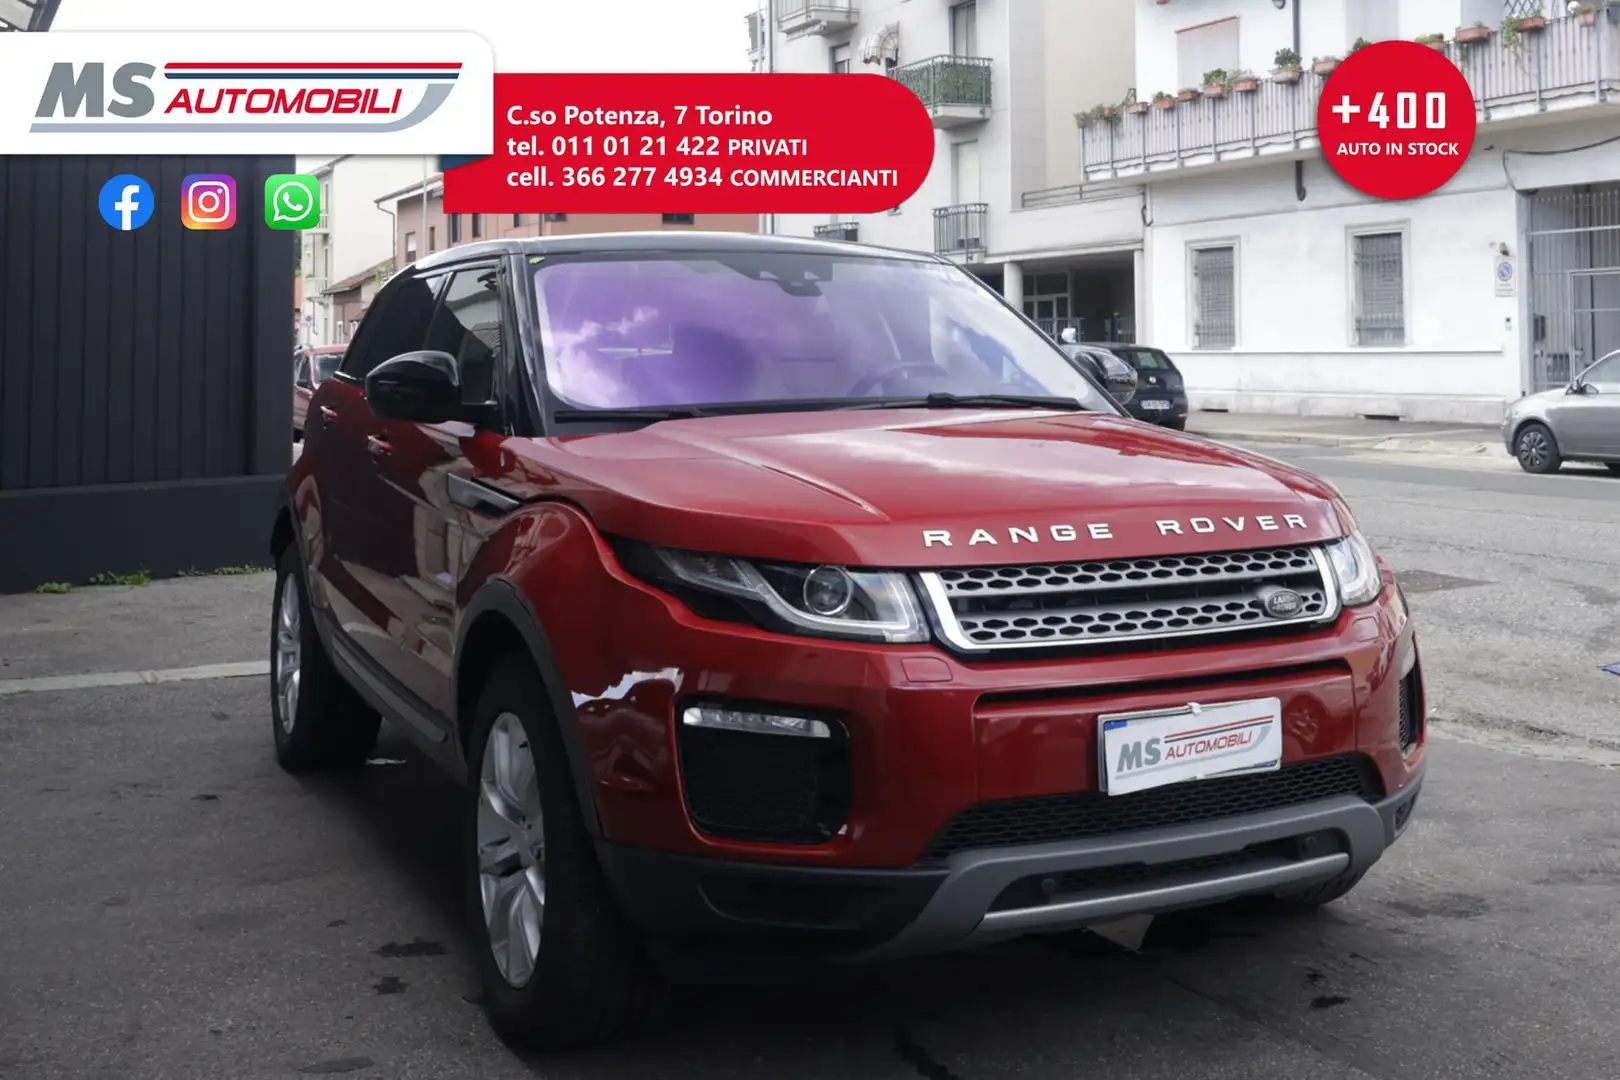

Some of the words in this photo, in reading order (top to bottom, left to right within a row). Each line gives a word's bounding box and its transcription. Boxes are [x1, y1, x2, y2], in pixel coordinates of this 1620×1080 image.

[923, 522, 1113, 547] RANGE
[1156, 513, 1308, 536] ROVER
[1116, 737, 1161, 773] MS
[1165, 731, 1253, 760] AUTOMOBILI
